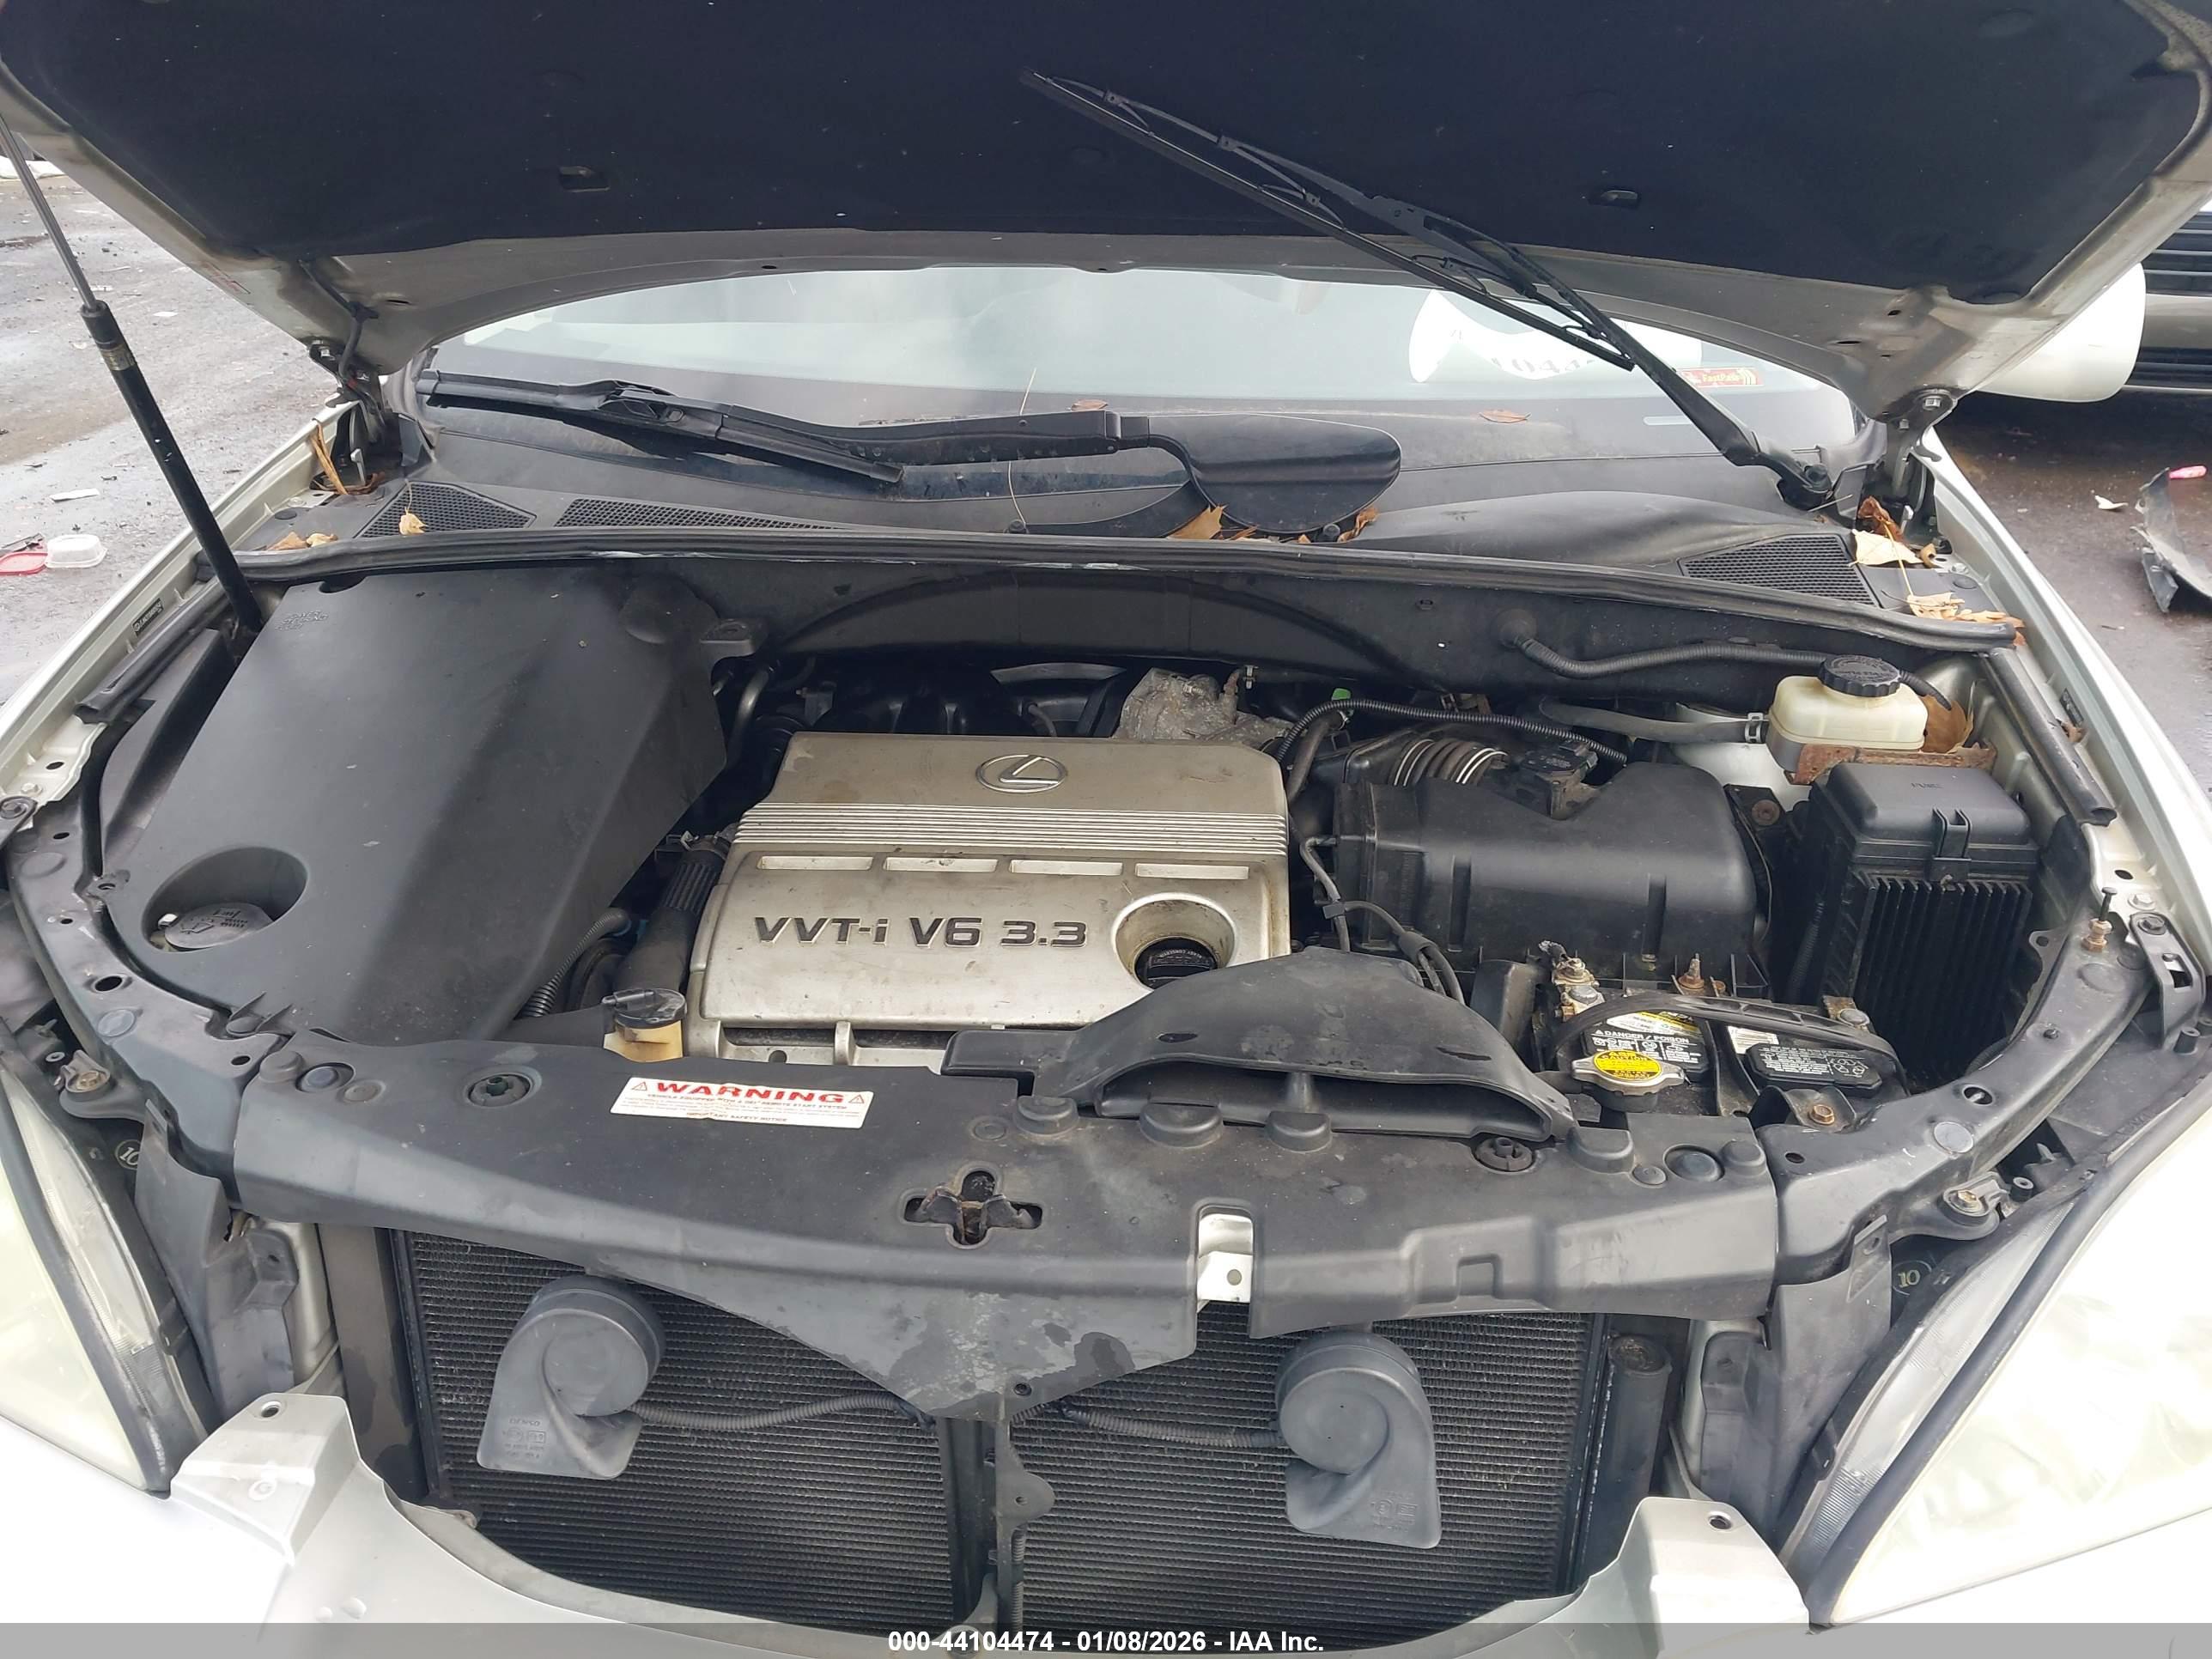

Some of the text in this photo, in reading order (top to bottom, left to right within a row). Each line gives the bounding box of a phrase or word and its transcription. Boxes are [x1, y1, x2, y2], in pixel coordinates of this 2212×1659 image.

[755, 916, 1087, 948] VVT-i V6 3.3
[1604, 1030, 1644, 1041] DANGER
[1654, 1035, 1690, 1043] POISON
[658, 1083, 844, 1103] WARNING
[1898, 1270, 1921, 1288] 10
